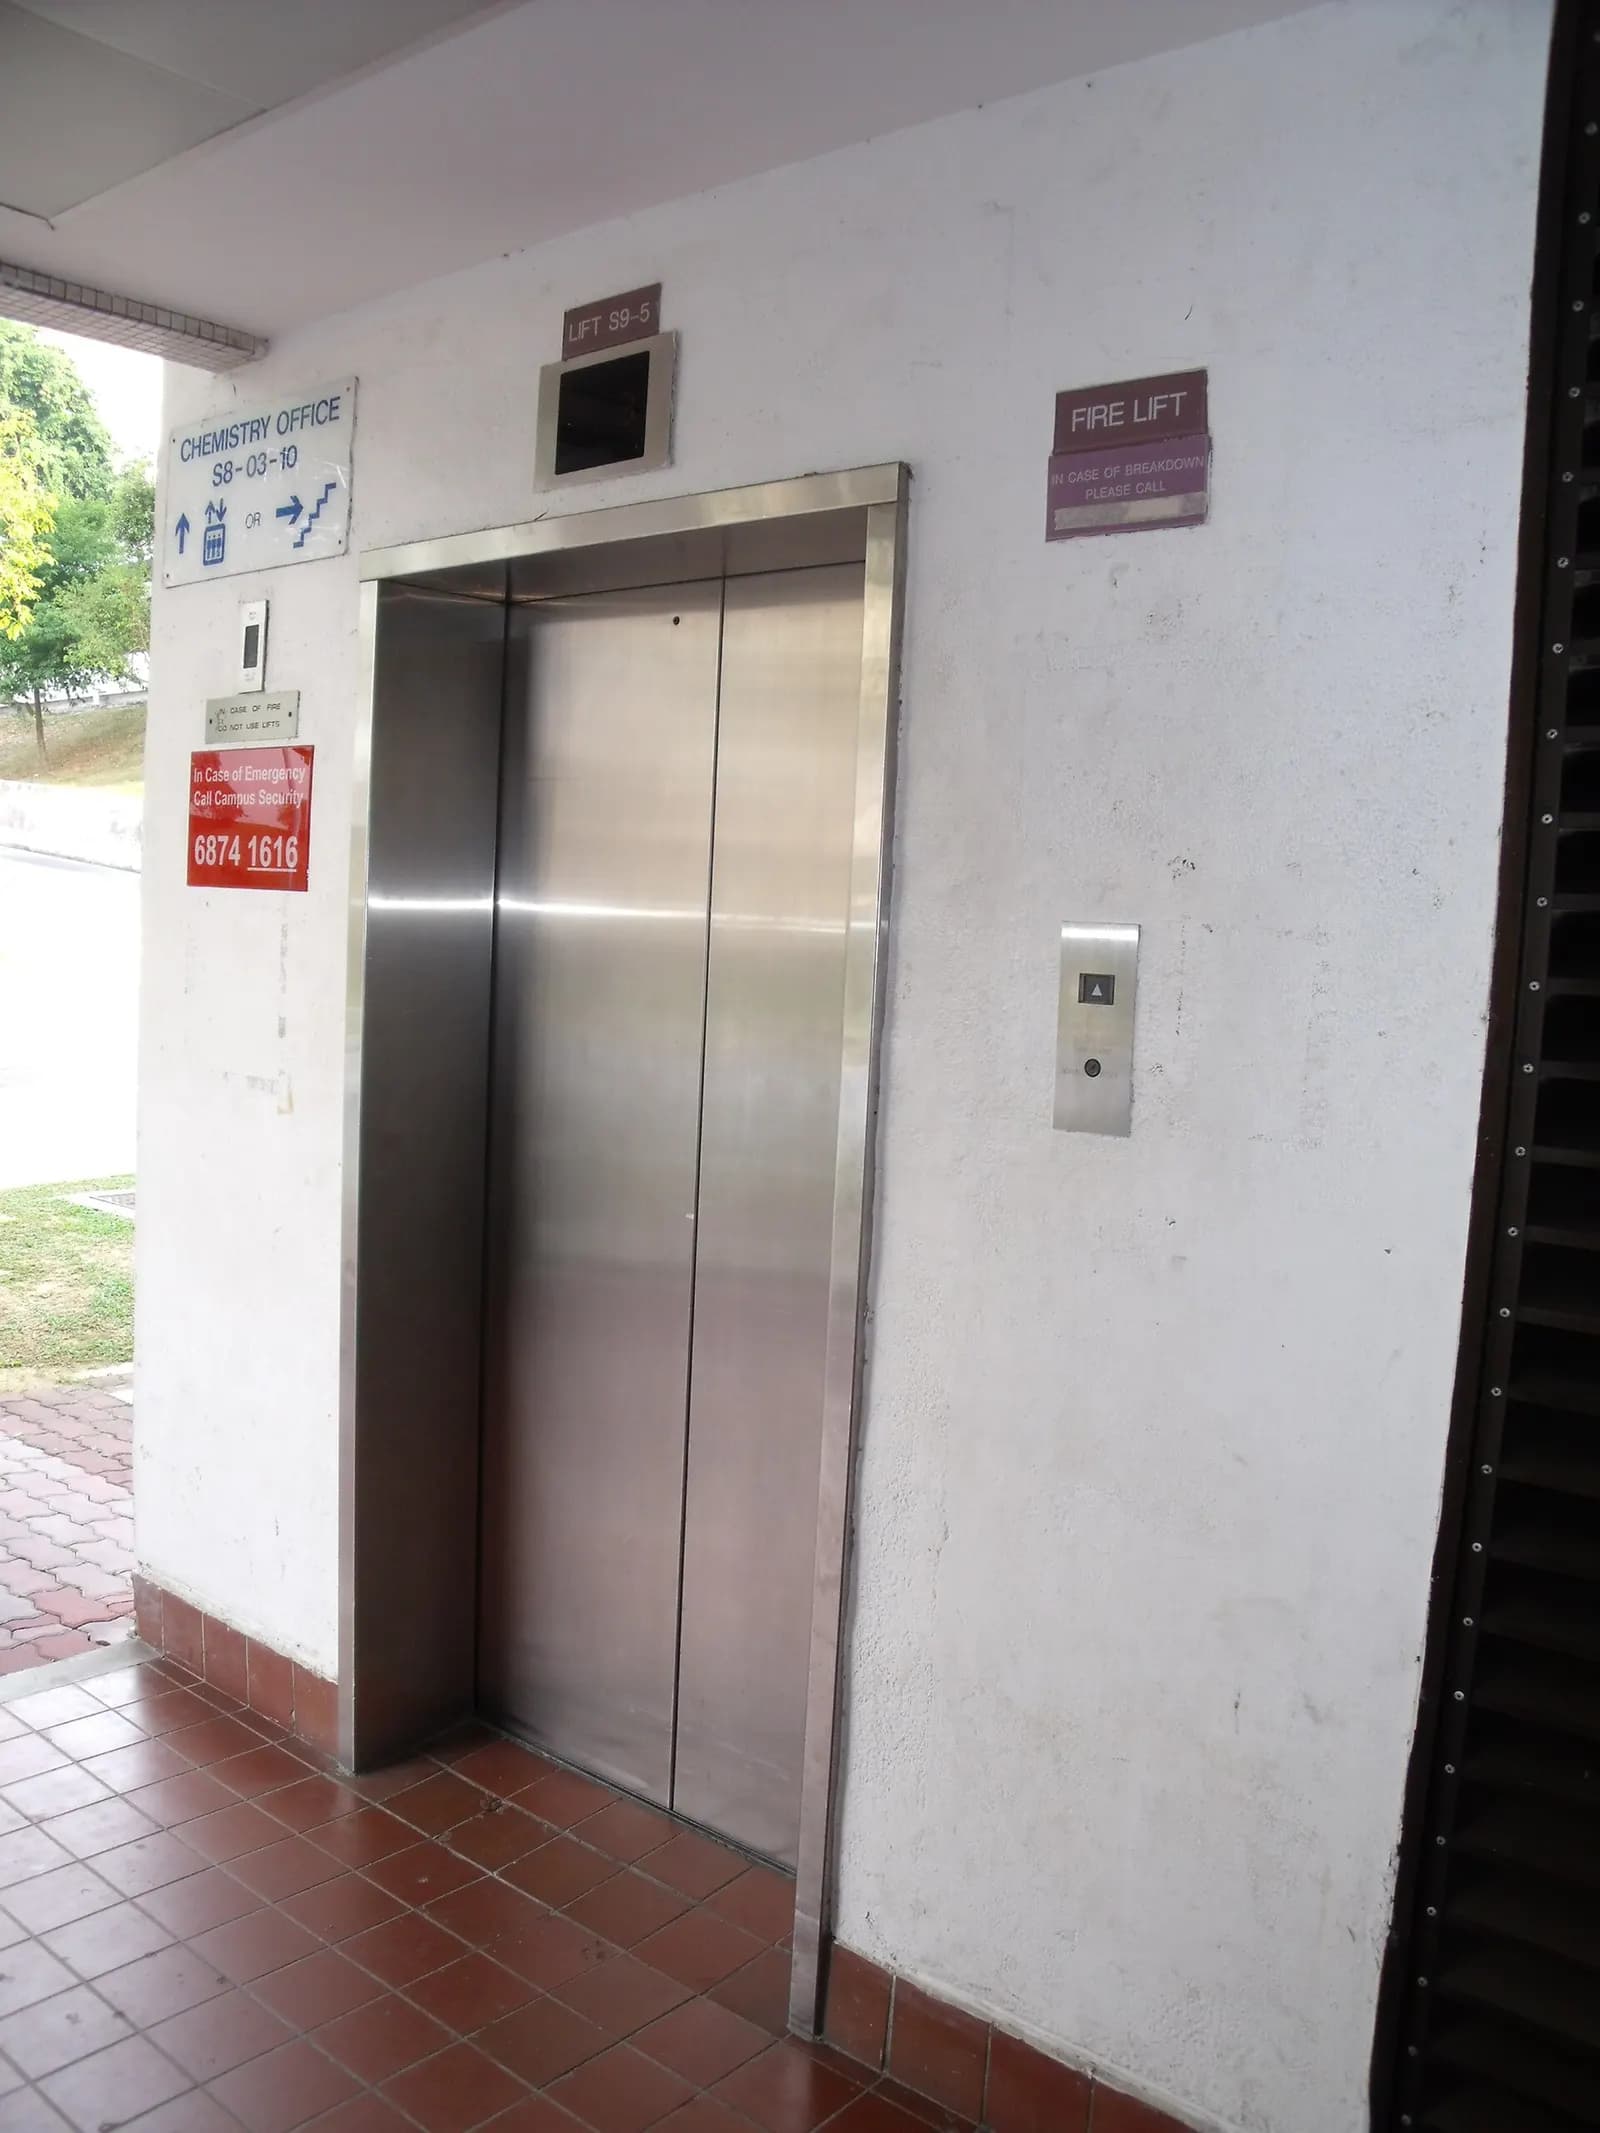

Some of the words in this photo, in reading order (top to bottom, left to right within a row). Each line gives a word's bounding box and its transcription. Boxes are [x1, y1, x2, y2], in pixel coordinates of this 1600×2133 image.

[569, 316, 602, 341] LIFT
[609, 302, 650, 331] S9-5
[1072, 402, 1125, 432] FIRE
[1133, 392, 1187, 422] LIFT
[180, 416, 272, 462] CHEMISTRY
[276, 396, 341, 435] OFFICE
[1052, 473, 1063, 485] IN
[1068, 468, 1099, 483] CASE
[1104, 466, 1121, 478] OF
[1125, 455, 1204, 476] BREAKDOWN
[1086, 484, 1131, 500] PLEASE
[1136, 480, 1167, 494] CALL
[245, 512, 261, 529] OR
[230, 706, 247, 714] CASE
[252, 704, 261, 712] OF
[267, 702, 281, 711] FIRE
[230, 723, 242, 731] NOT
[246, 721, 259, 729] USE
[262, 720, 280, 728] LIFTS
[193, 768, 203, 782] In
[205, 767, 229, 782] Case
[232, 765, 243, 781] of
[245, 765, 306, 784] Emergency
[194, 790, 212, 806] Call
[214, 790, 256, 808] Campus
[258, 788, 305, 808] Security
[194, 835, 241, 866] 6874
[247, 835, 298, 868] 1616
